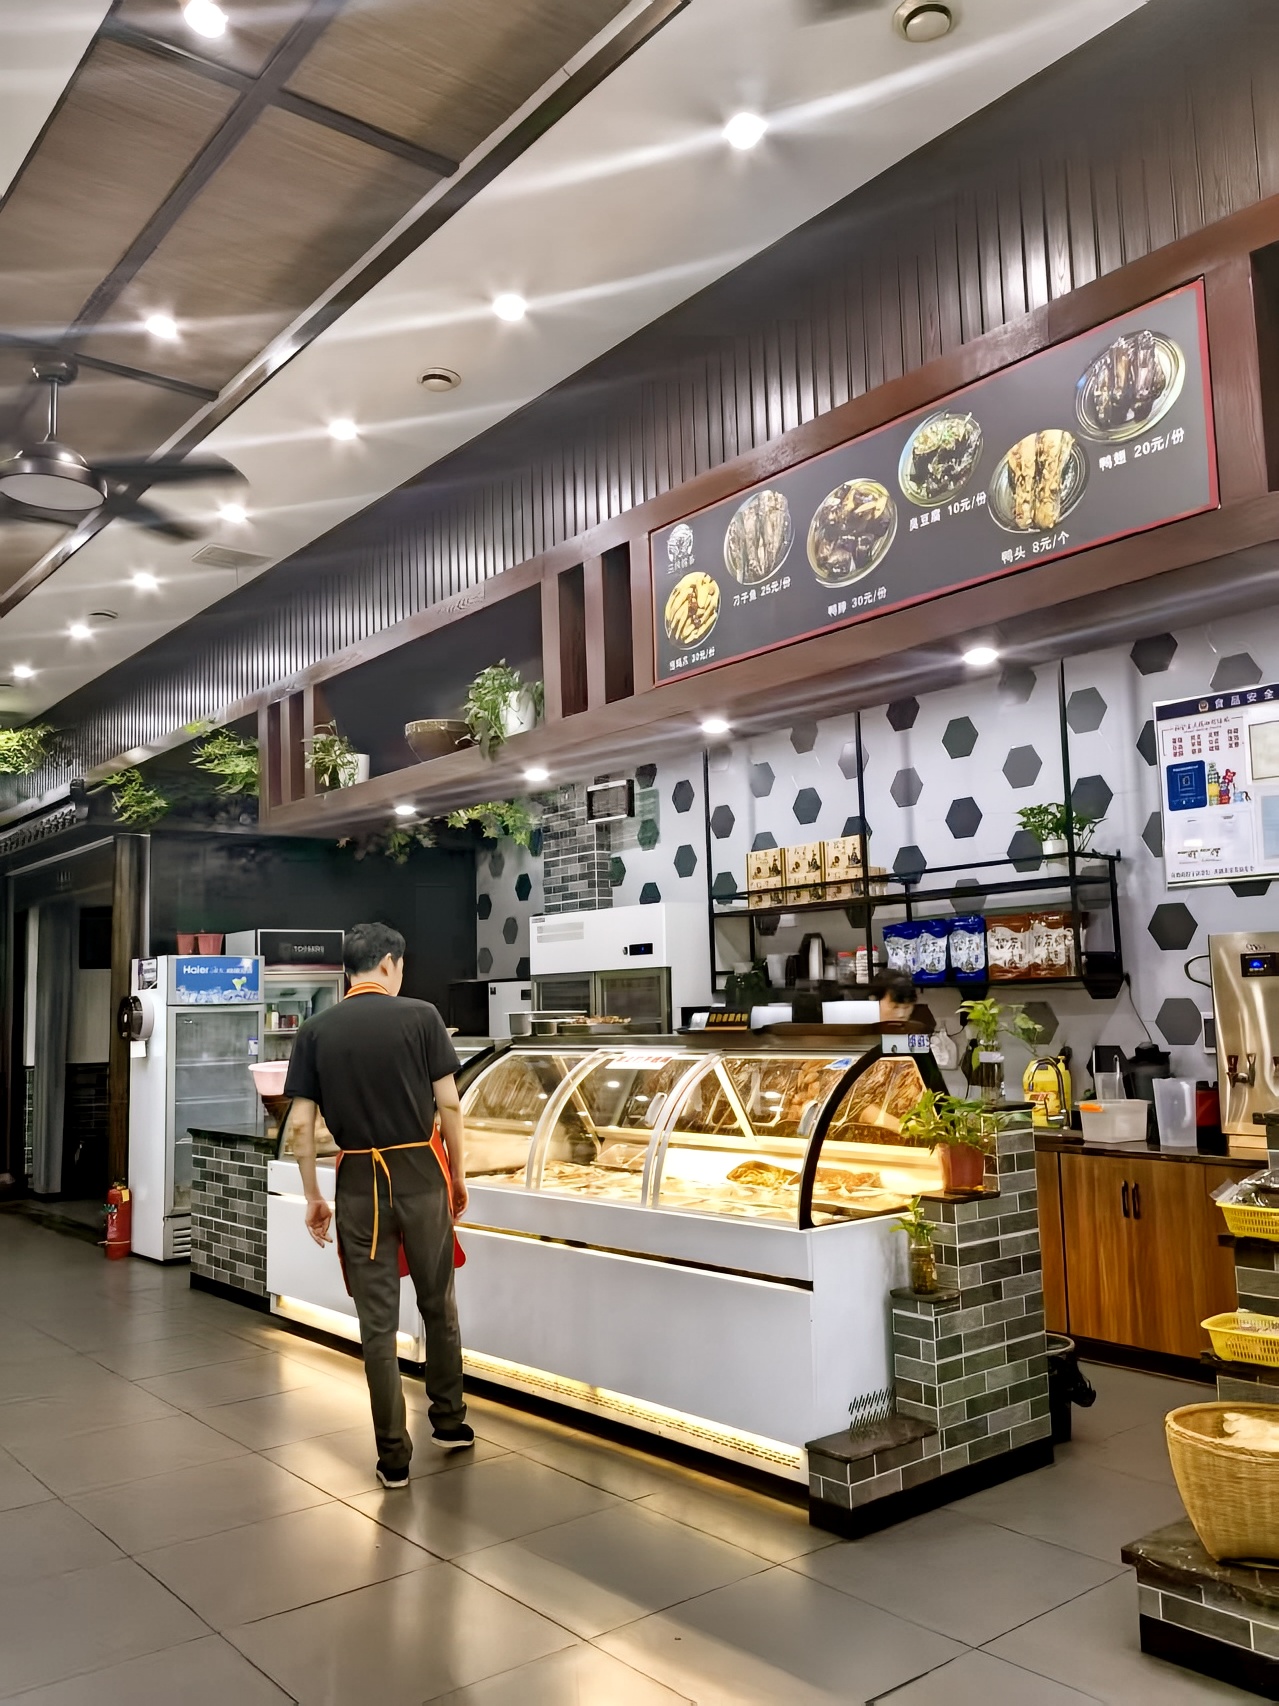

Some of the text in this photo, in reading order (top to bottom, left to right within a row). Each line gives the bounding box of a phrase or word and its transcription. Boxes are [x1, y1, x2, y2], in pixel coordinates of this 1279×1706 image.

[1134, 427, 1185, 458] 20元/份
[947, 491, 986, 516] 10元/份
[1001, 531, 1070, 564] 鸭头 8元/个
[760, 576, 791, 597] 25元/份
[851, 586, 887, 608] 30元/份
[1214, 689, 1274, 709] 食品安全
[183, 964, 209, 975] Haier
